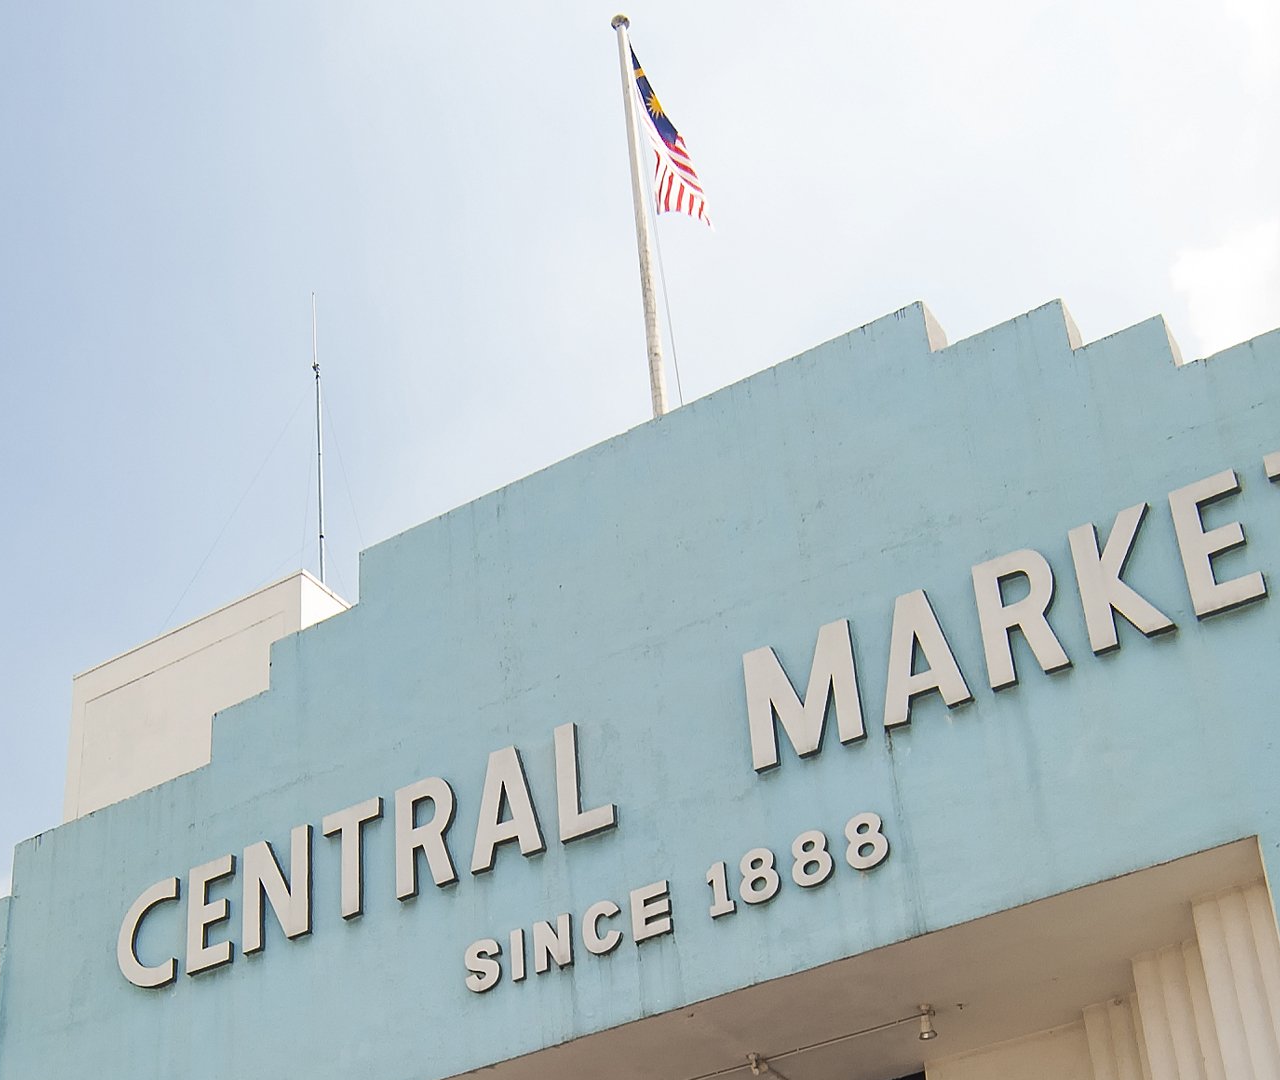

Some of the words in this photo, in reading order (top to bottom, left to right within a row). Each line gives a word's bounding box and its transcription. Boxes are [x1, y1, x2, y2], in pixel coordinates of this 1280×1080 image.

[117, 721, 618, 989] CENTRAL
[464, 879, 674, 993] SINCE
[706, 811, 890, 919] 1888
